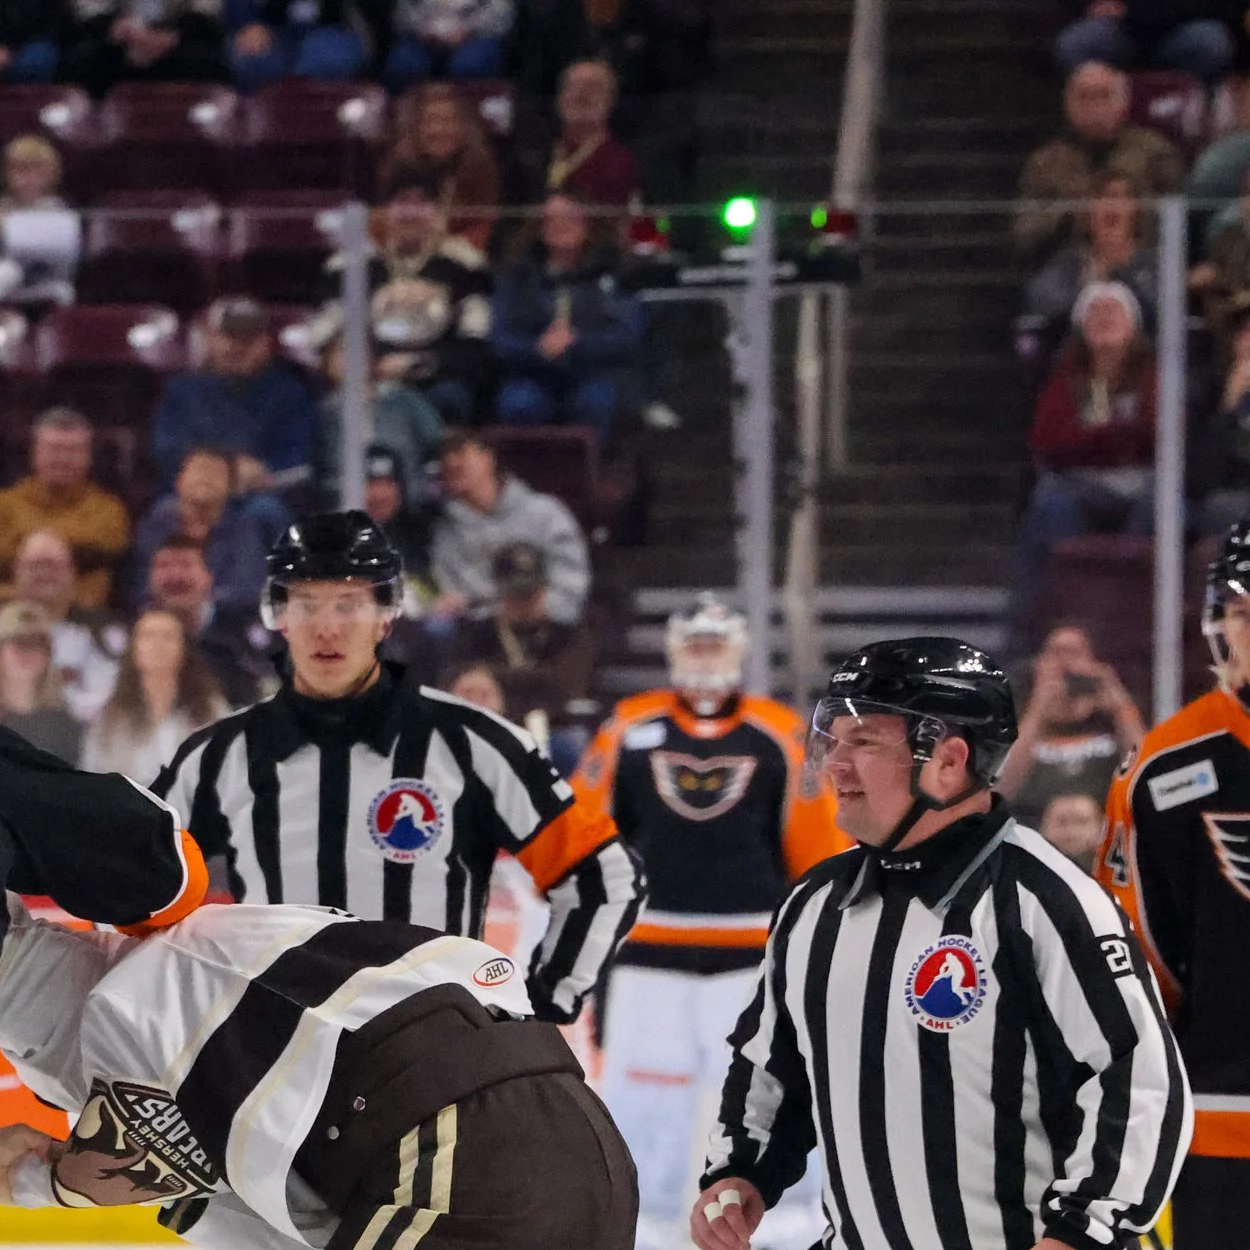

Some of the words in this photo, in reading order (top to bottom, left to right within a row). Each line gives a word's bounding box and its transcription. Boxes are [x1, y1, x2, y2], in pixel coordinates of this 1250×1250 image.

[832, 672, 859, 683] CCM
[485, 961, 509, 982] AHL
[904, 946, 934, 1015] AMERICAN
[938, 937, 982, 963] HOCKEY
[960, 968, 987, 1024] LEAGUE
[926, 1019, 954, 1030] AHL
[130, 1118, 190, 1169] HERSHEY
